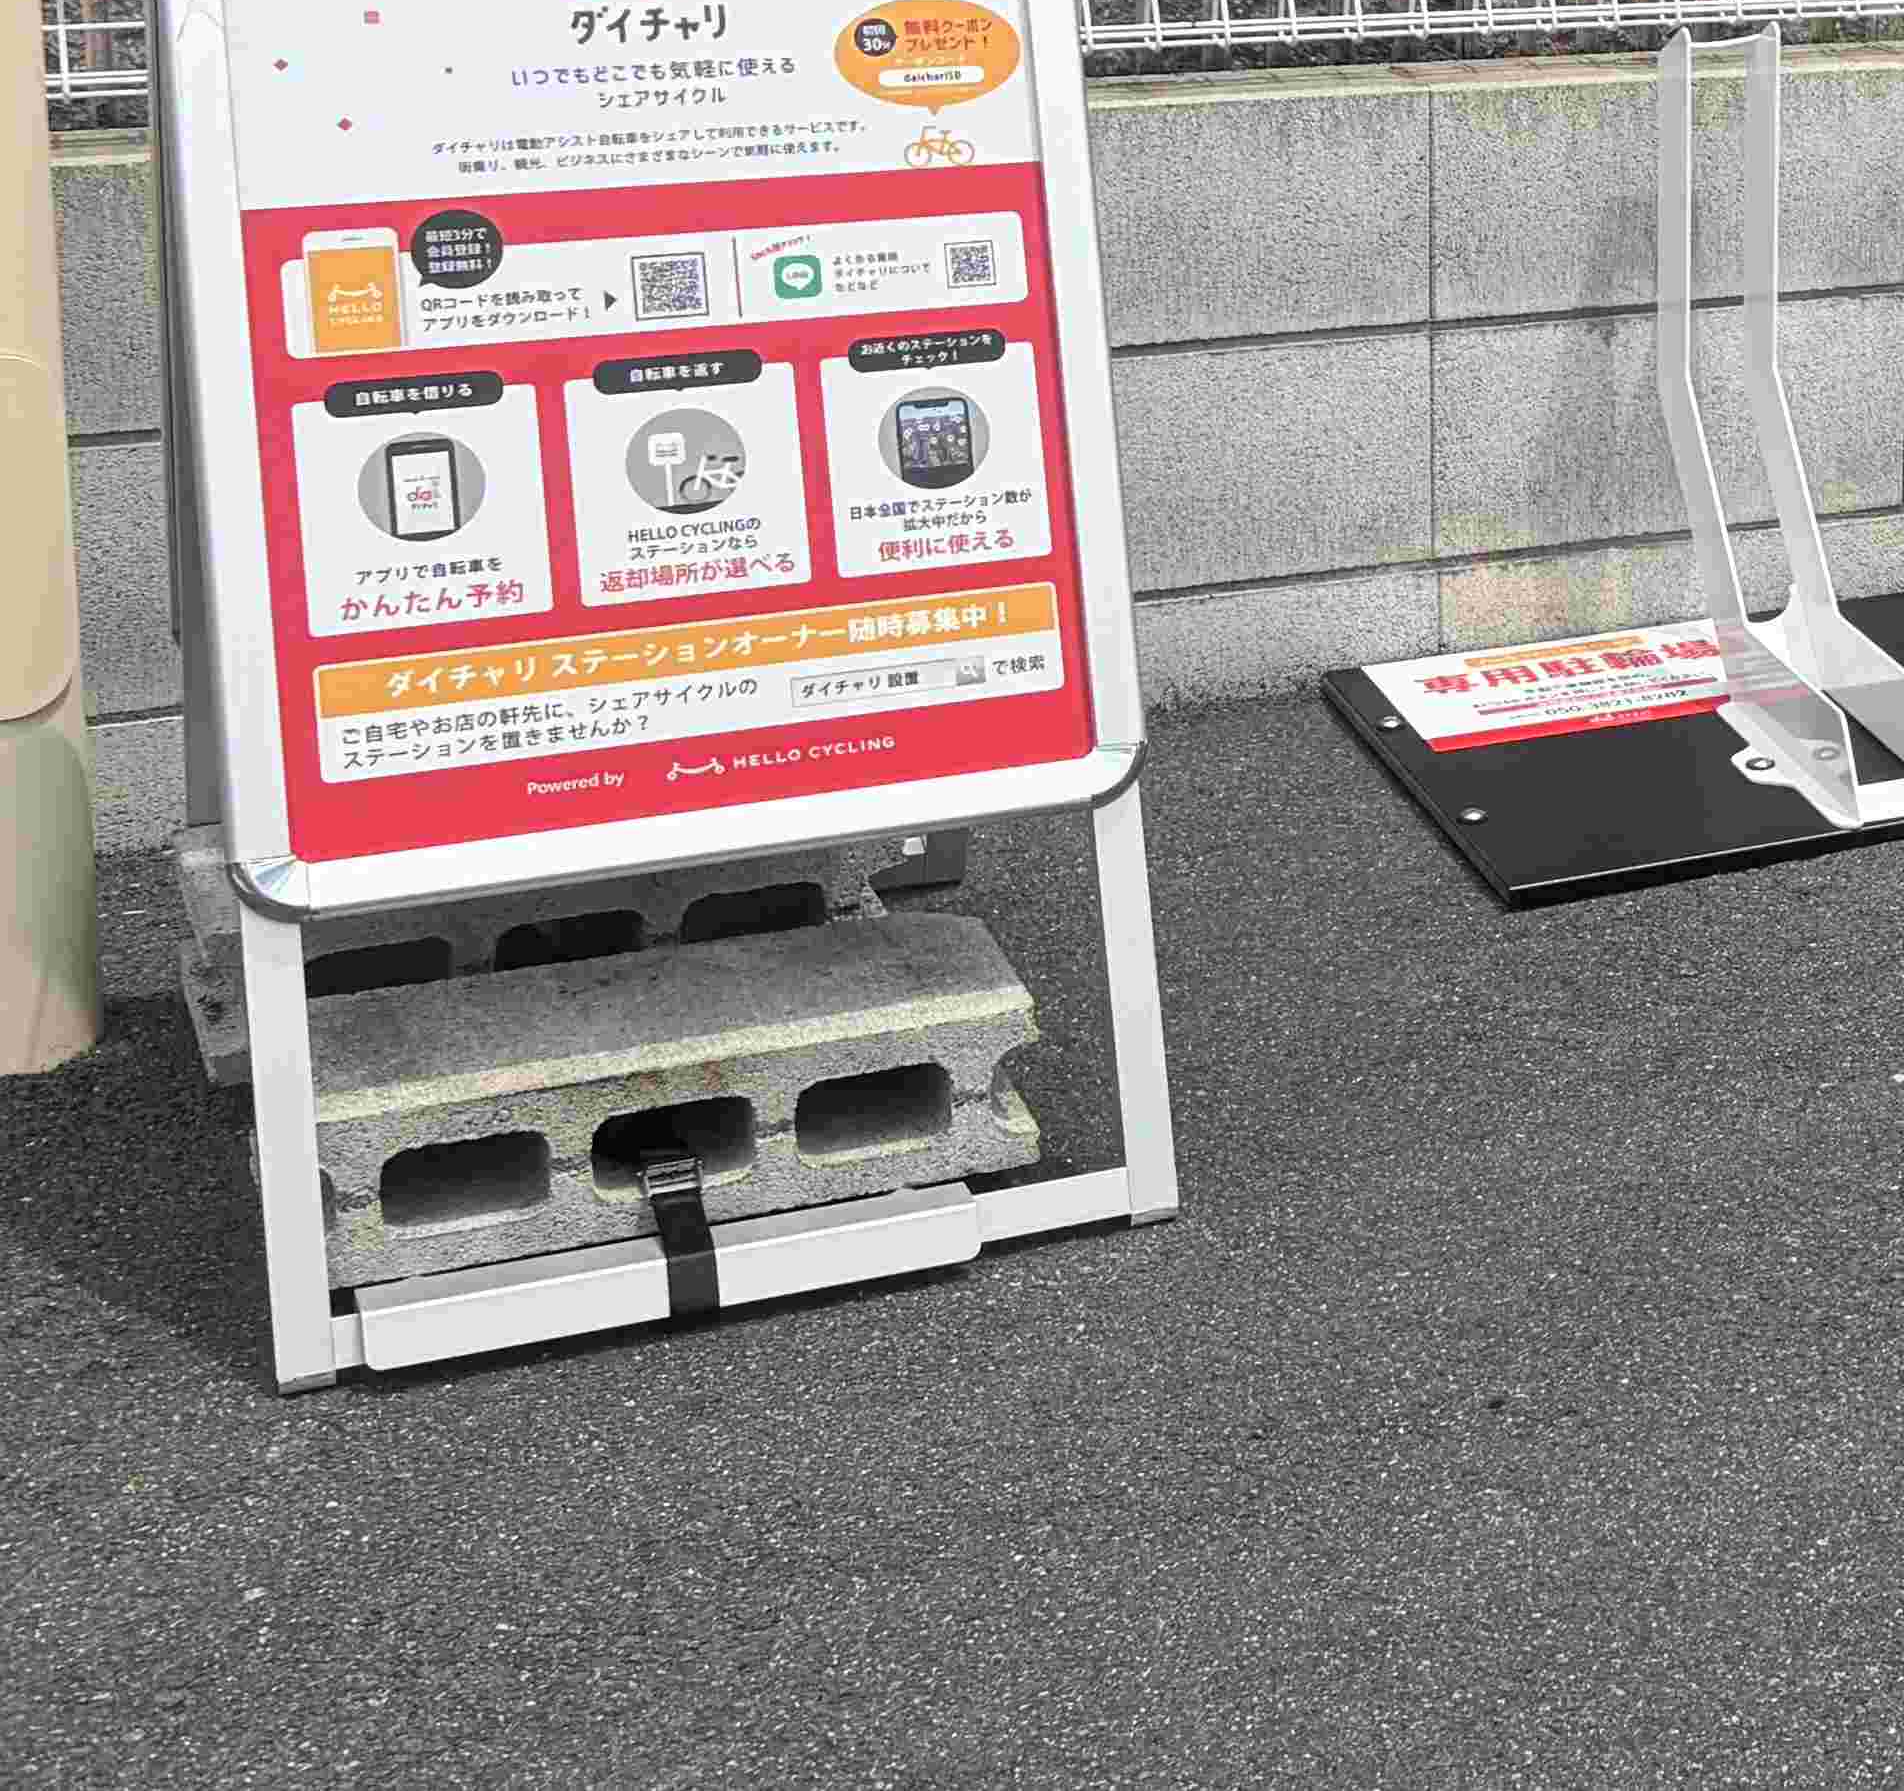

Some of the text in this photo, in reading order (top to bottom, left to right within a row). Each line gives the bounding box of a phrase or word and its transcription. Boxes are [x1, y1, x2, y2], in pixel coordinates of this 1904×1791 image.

[571, 4, 726, 44] ダイチャリ
[904, 18, 992, 34] 無料クーポン
[511, 58, 796, 86] いつでもどこでも気軽に使える
[599, 88, 727, 108] シェアサイクル
[420, 287, 583, 312] QRコードを読み取って
[423, 306, 591, 332] アプリをダウンロード！
[861, 334, 993, 355] お近くのステーションを
[630, 362, 725, 383] 自転車を返す
[355, 384, 473, 407] 自転車を借りる
[850, 489, 1032, 520] 日本全国でステーション数が
[628, 517, 761, 542] HELLO CYCLINGの
[903, 510, 987, 532] 拡大中だから
[630, 535, 758, 560] ステーションなら
[879, 529, 1014, 562] 便利に使える
[355, 557, 503, 585] アプリで自転車を
[600, 553, 795, 592] 返却場所が選べる
[340, 578, 525, 621] かんたん予約
[386, 601, 1007, 698] ダイチャリ ステーションオーナー随時募集中！
[991, 655, 1046, 676] で検索
[1413, 638, 1721, 695] 専用駐輪場
[801, 671, 920, 699] ダイチャリ 設置
[341, 677, 758, 746] ご自宅やお店の軒先に、シェアサイクルの
[342, 713, 650, 770] ステーションを置きませんか？
[732, 735, 896, 770] HELLO CYCLING
[527, 770, 625, 796] Powered by
